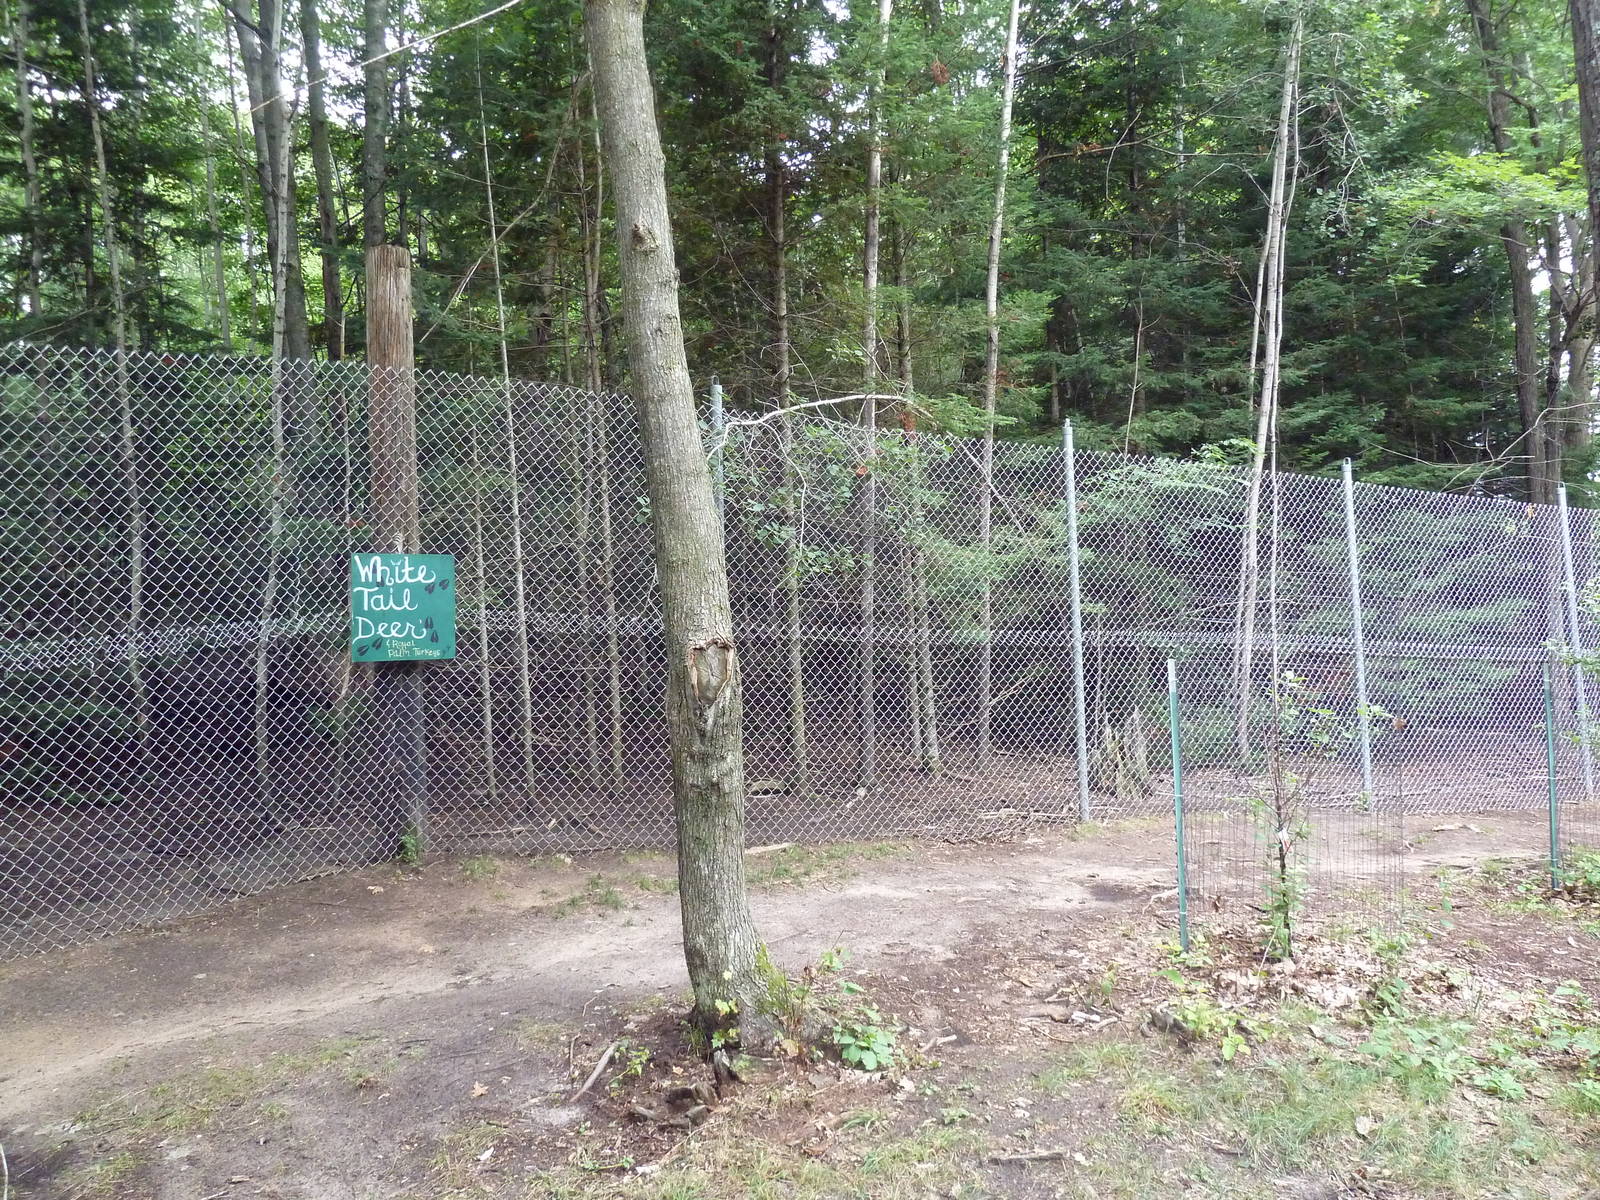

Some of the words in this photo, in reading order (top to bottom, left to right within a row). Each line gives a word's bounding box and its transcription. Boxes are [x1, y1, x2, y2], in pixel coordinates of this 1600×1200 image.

[354, 555, 436, 585] White
[353, 587, 418, 611] Tail
[353, 617, 426, 644] Deer
